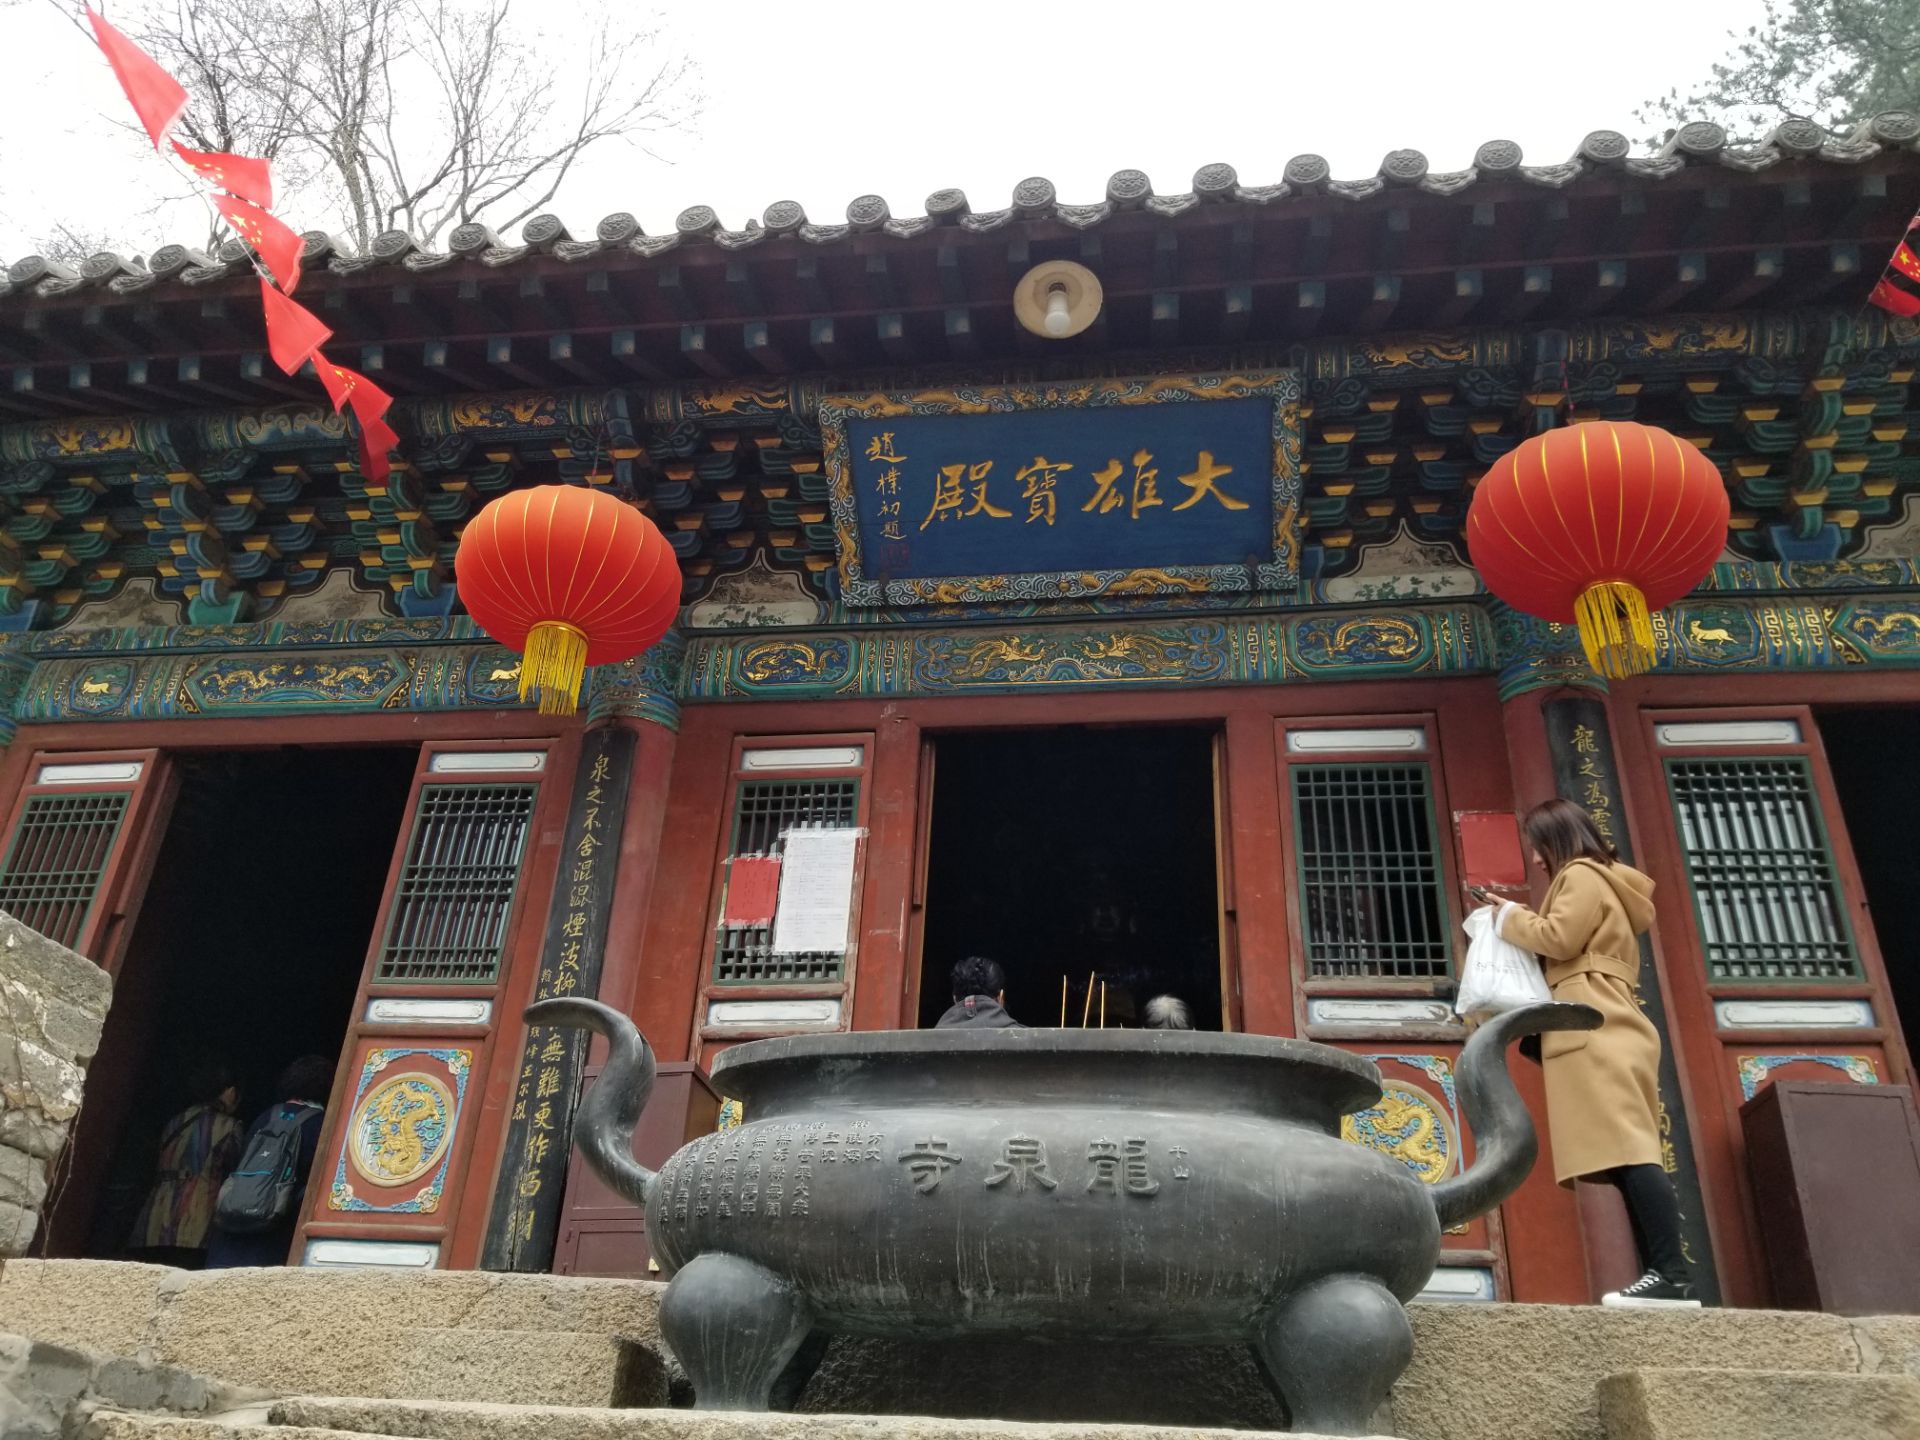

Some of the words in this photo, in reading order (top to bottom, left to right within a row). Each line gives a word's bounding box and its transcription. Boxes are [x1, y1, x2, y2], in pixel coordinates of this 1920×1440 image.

[919, 449, 1250, 531] 大雄寶殿
[897, 1133, 1160, 1195] 龍泉寺
